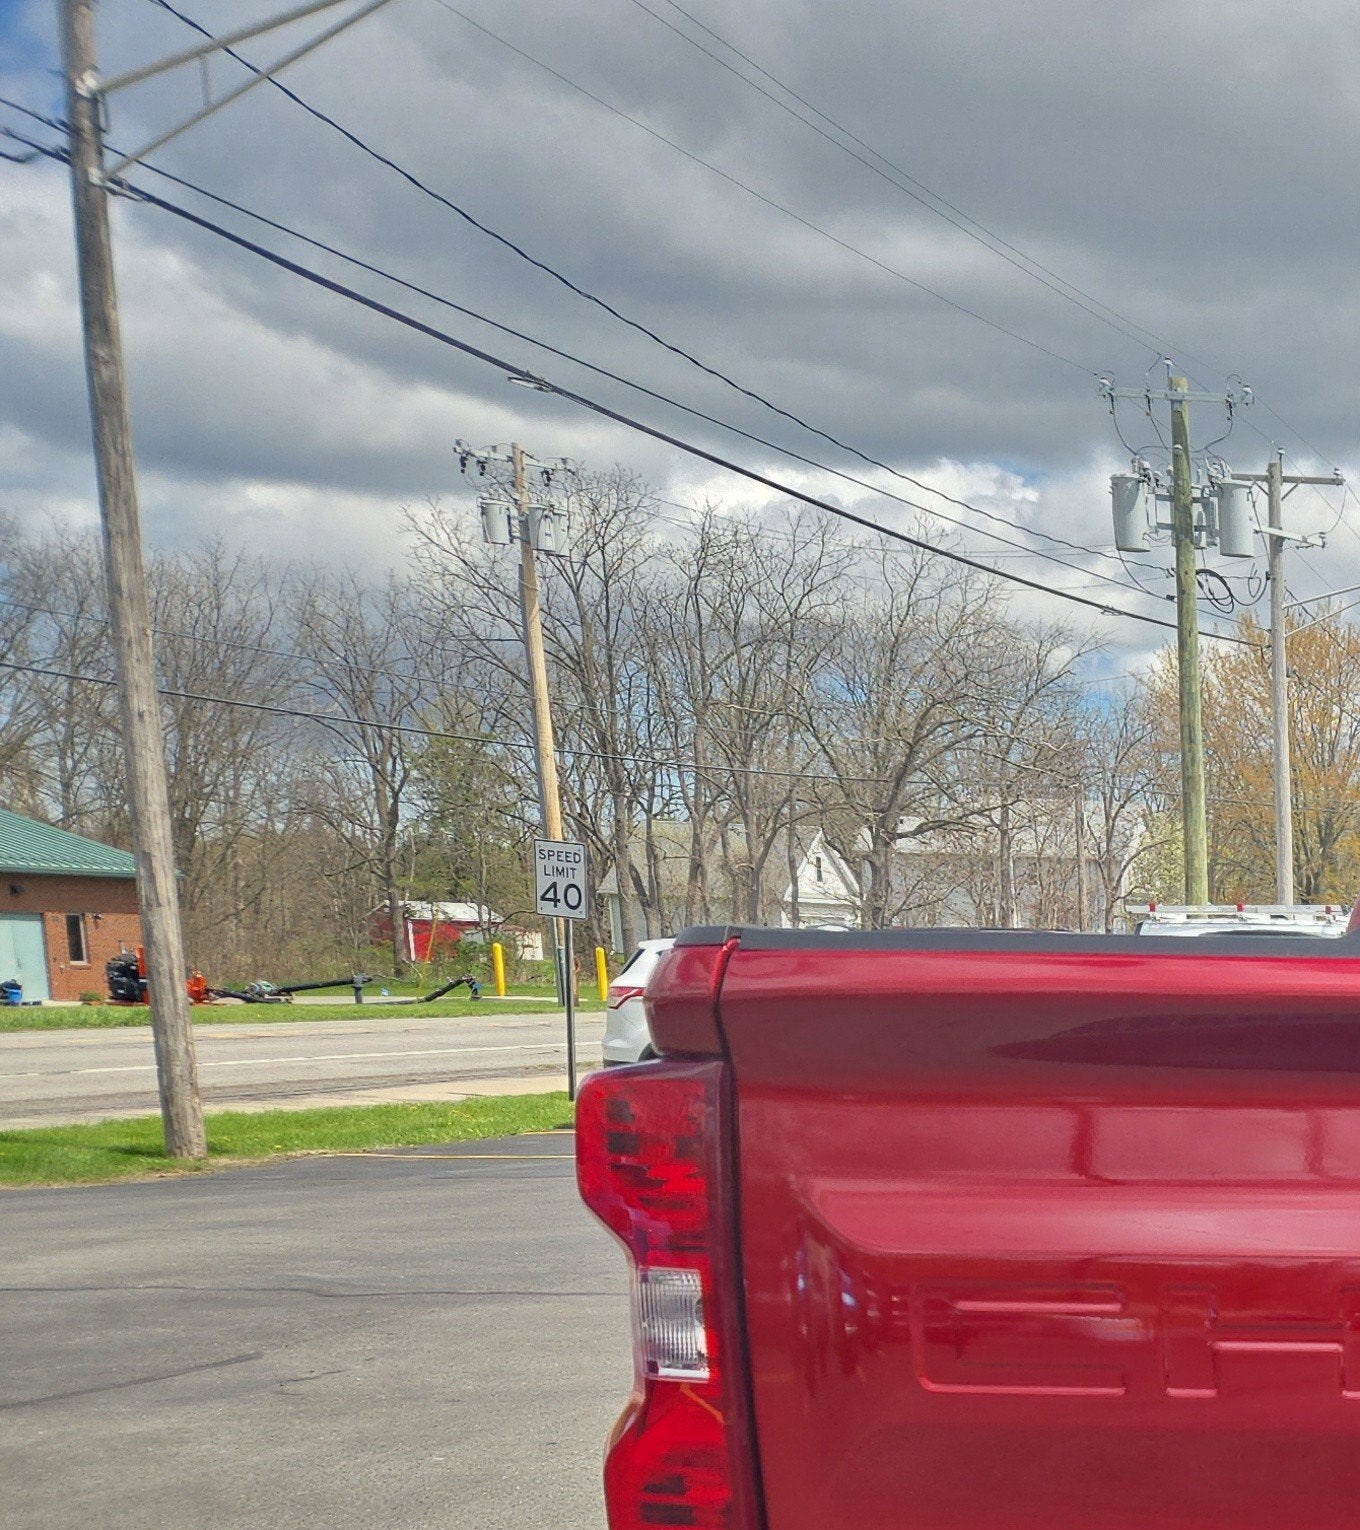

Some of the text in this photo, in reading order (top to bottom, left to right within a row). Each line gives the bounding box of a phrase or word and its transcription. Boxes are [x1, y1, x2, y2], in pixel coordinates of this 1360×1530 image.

[538, 848, 581, 863] SPEED
[543, 864, 577, 879] LIMIT
[540, 881, 582, 910] 40
